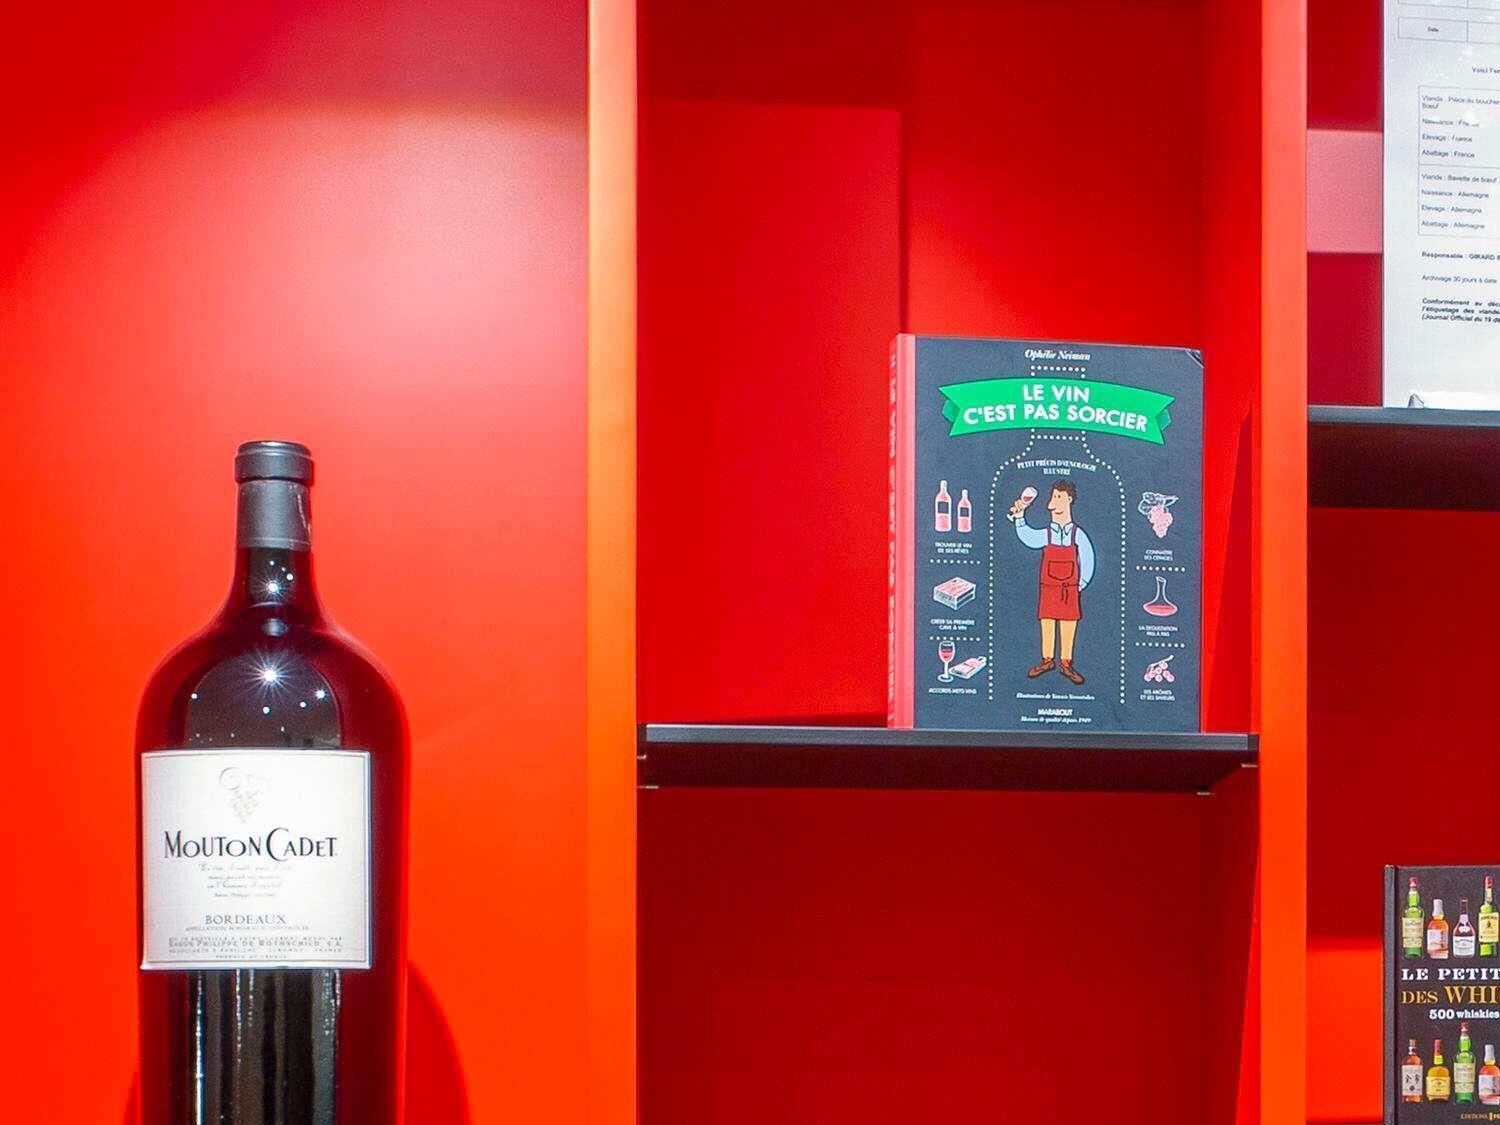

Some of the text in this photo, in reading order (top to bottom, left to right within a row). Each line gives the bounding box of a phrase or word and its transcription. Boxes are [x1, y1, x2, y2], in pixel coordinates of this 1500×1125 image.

[1422, 297, 1470, 306] Conformément
[1450, 314, 1473, 322] Officiel
[1023, 384, 1090, 403] LE VIN
[963, 403, 1148, 432] C'EST PAS SORCIER
[204, 914, 287, 926] BORDEAUX
[1401, 967, 1429, 981] LE
[1401, 990, 1439, 1005] DES
[1429, 1009, 1455, 1020] 500
[1456, 1009, 1500, 1019] whiskies
